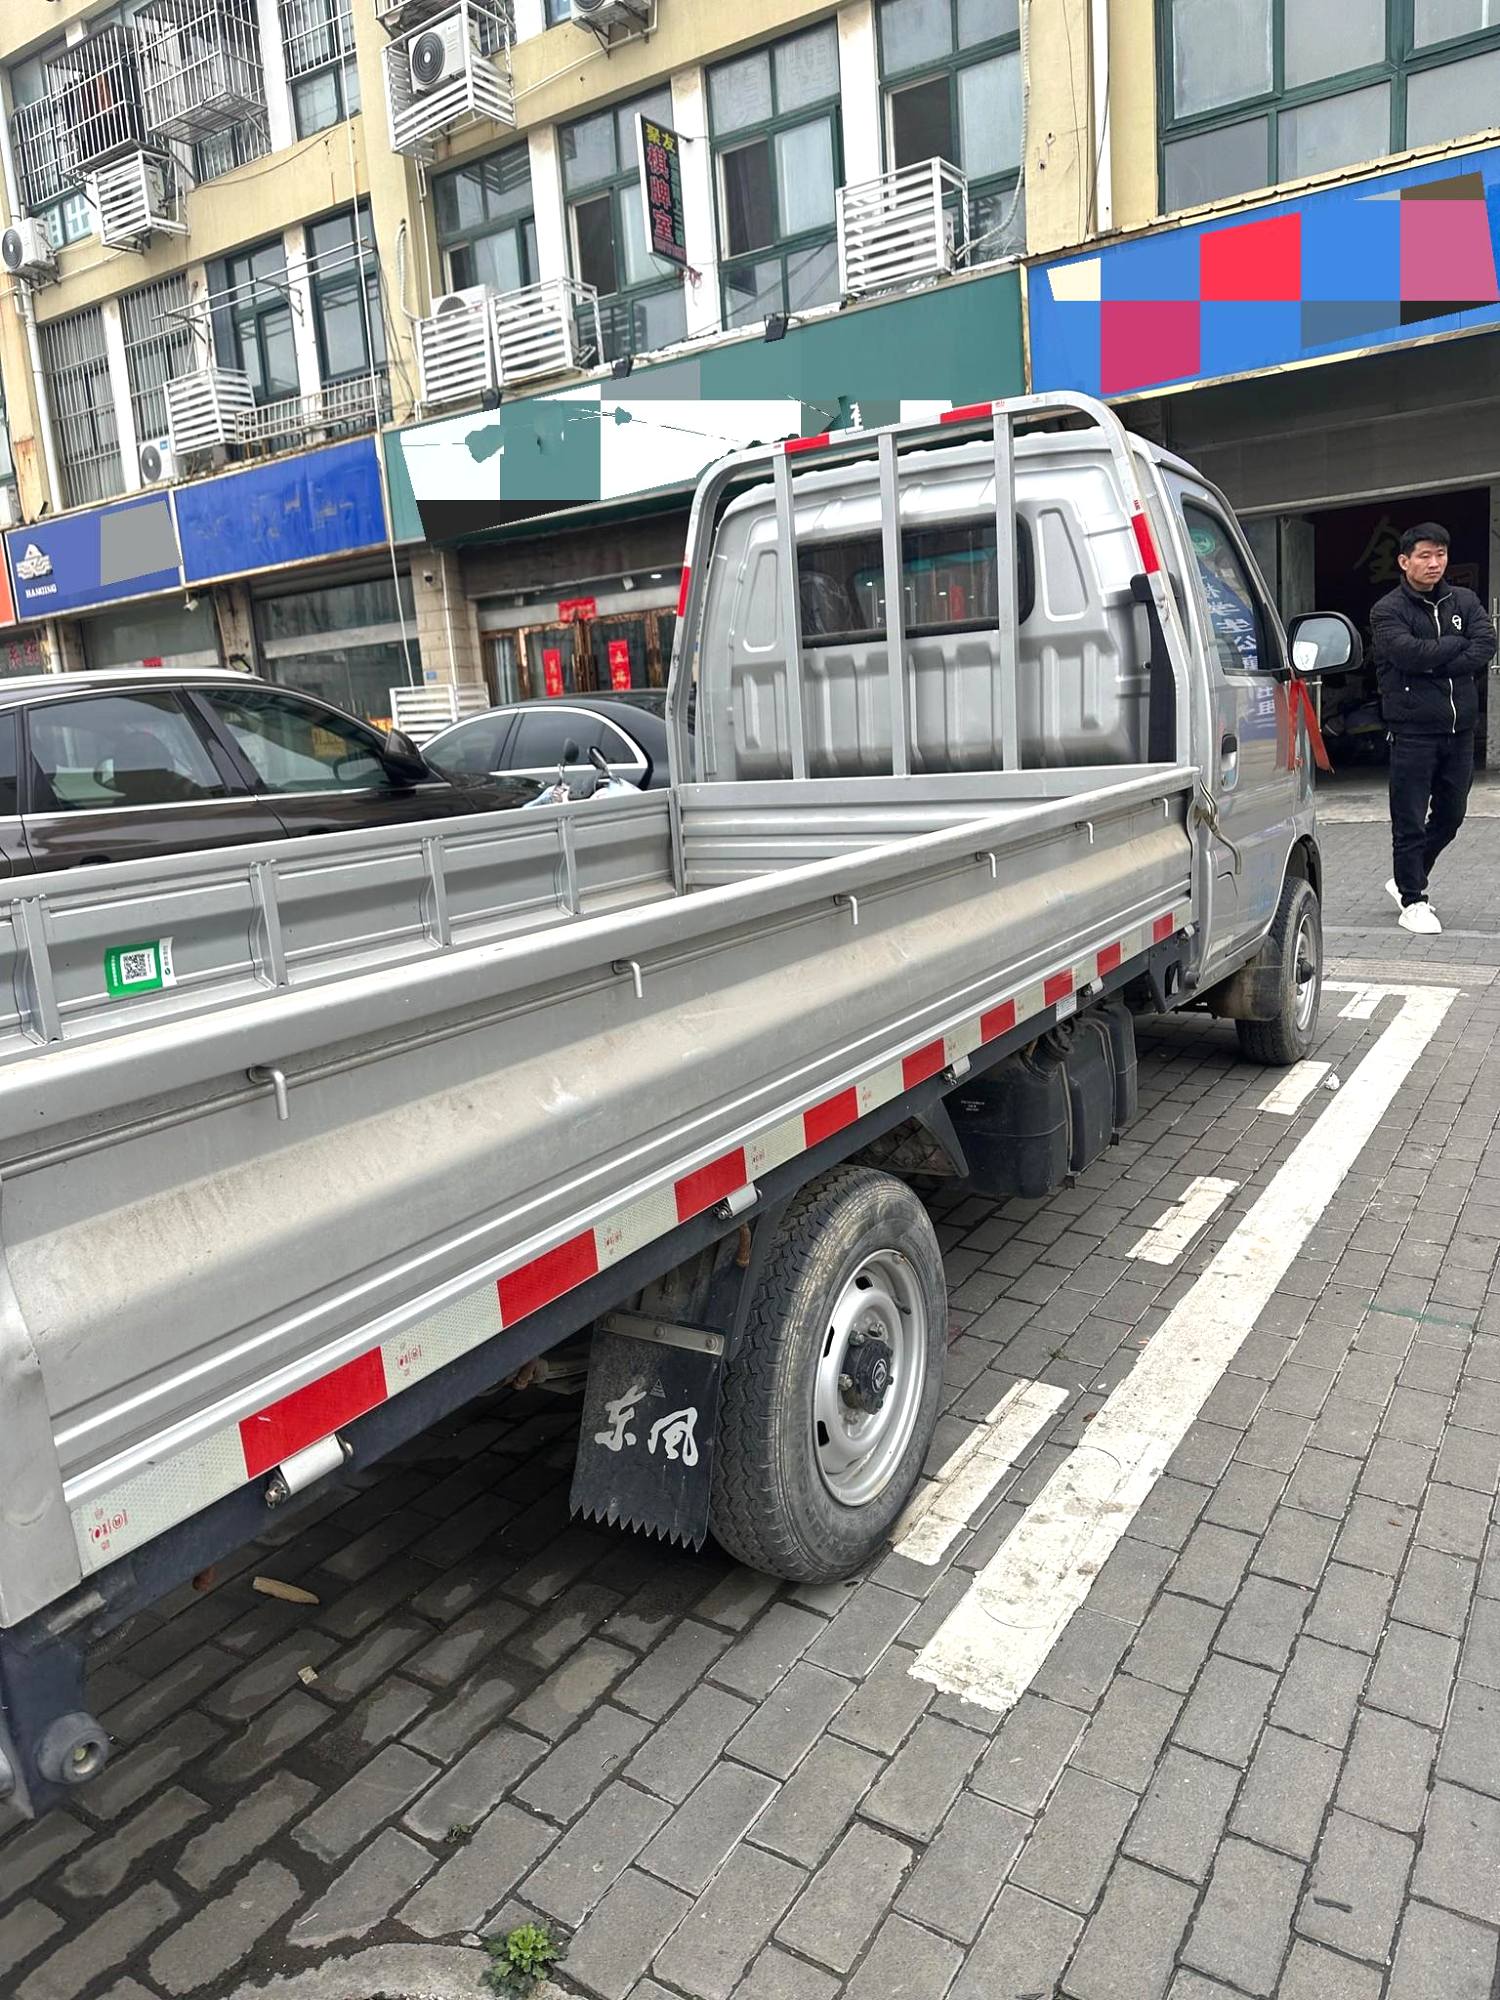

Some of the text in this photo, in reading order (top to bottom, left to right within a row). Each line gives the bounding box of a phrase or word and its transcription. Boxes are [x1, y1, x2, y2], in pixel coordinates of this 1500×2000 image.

[645, 123, 676, 154] 聚友
[647, 143, 674, 244] 棋牌室
[594, 1384, 699, 1467] 东风
